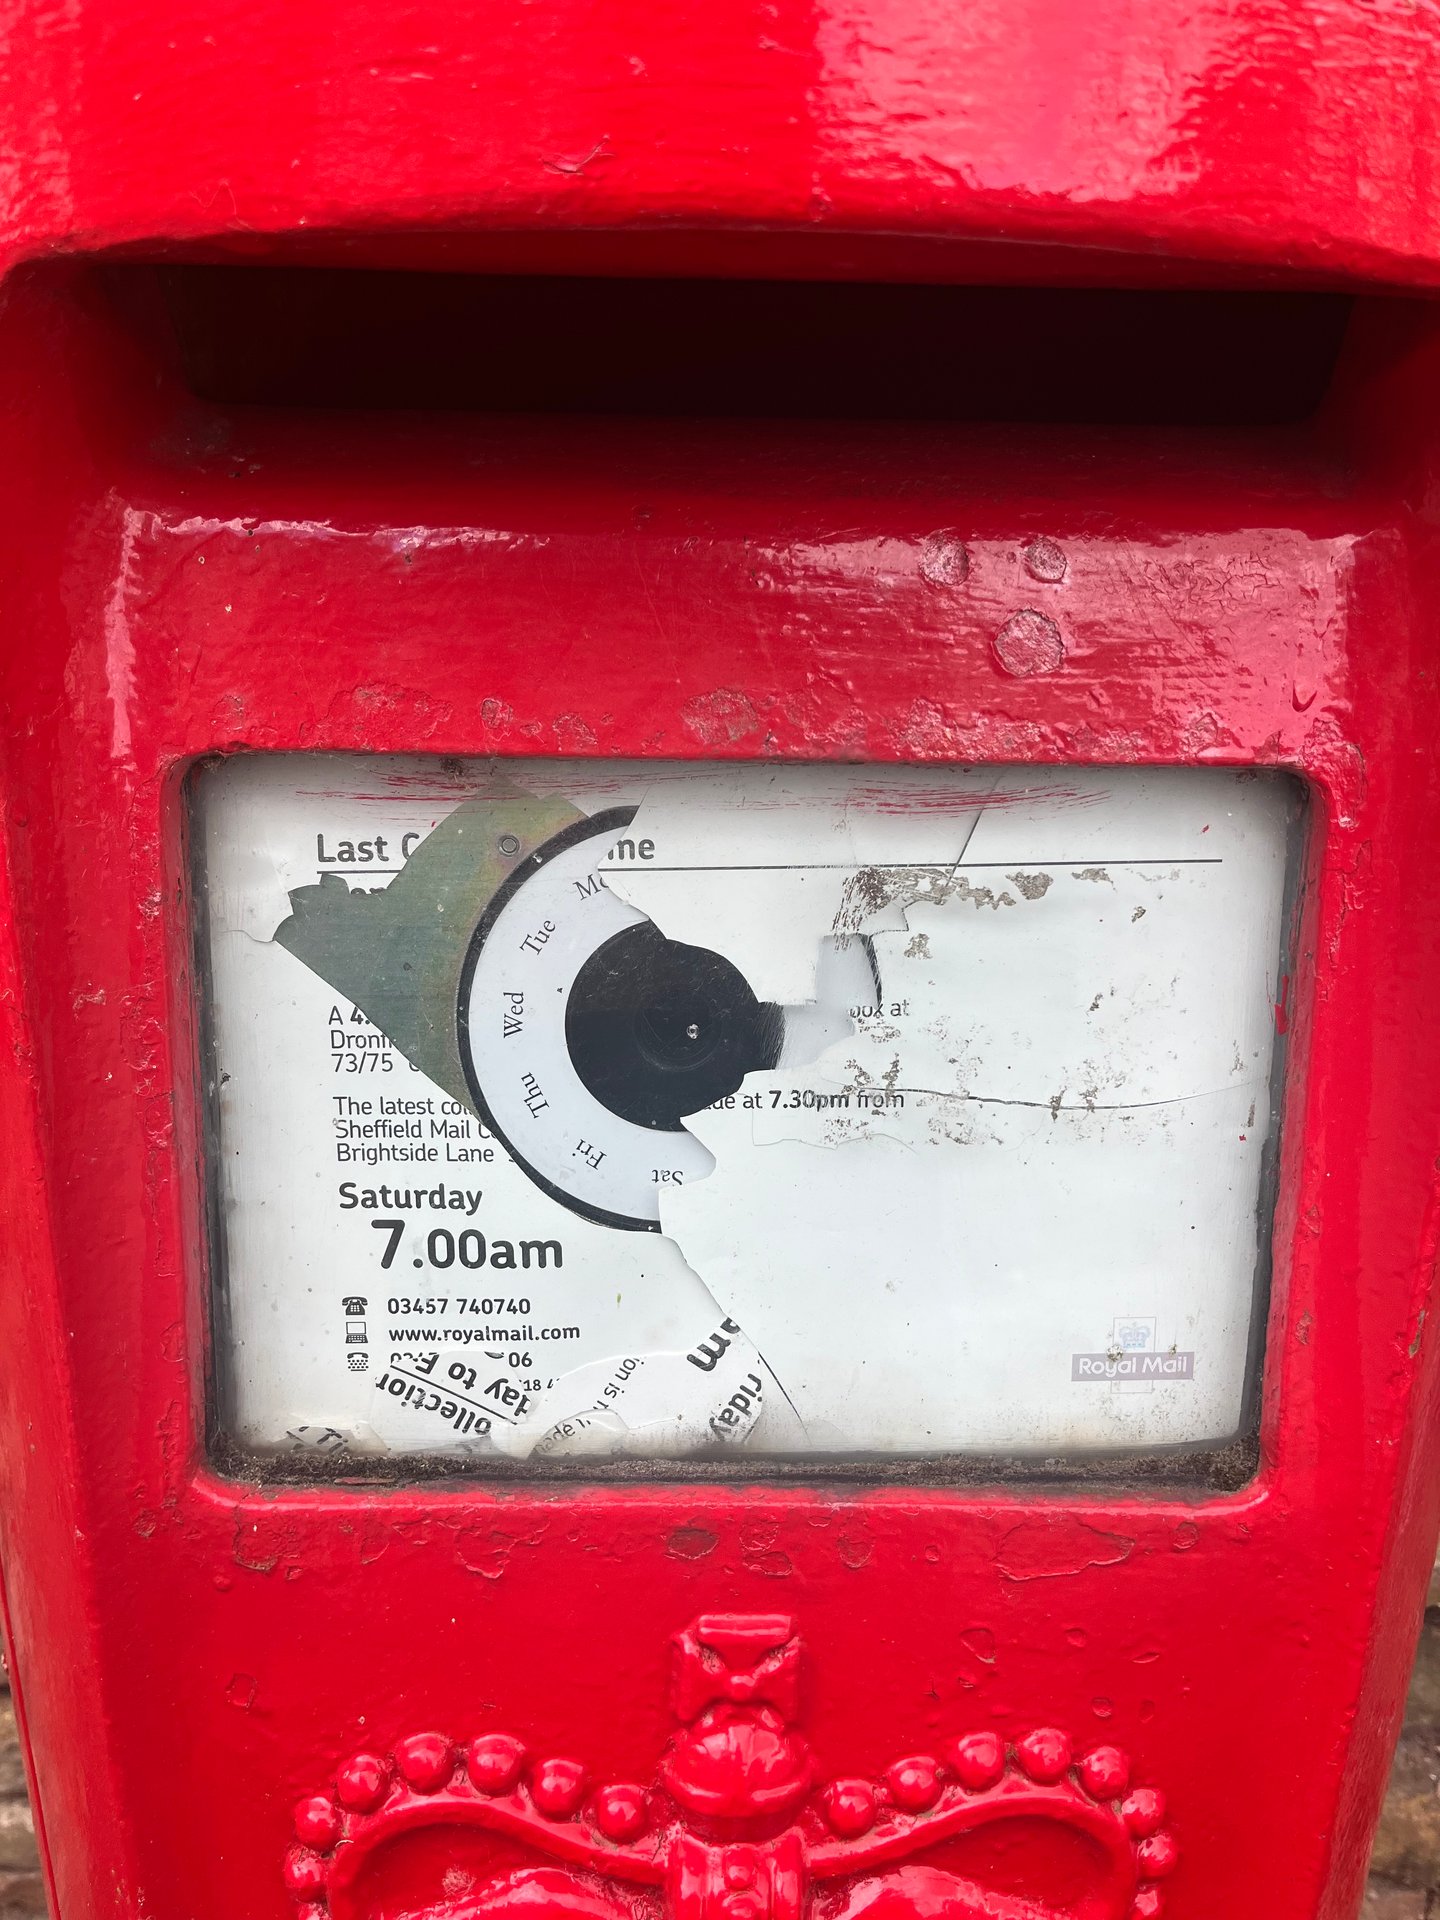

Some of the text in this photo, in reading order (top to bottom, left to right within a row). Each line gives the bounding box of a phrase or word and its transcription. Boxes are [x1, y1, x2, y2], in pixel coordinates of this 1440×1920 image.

[317, 833, 390, 862] Last
[608, 838, 655, 860] me
[519, 919, 556, 955] Tue
[328, 1005, 371, 1026] A 4.
[503, 992, 524, 1039] Wed
[889, 999, 910, 1017] at
[331, 1051, 394, 1074] 73/75
[332, 1095, 373, 1116] The
[379, 1096, 436, 1116] latest
[742, 1092, 763, 1110] at
[768, 1088, 849, 1112] 7.30pm
[521, 1072, 549, 1118] Thu
[335, 1119, 423, 1138] Sheffield
[431, 1118, 471, 1138] Mail
[337, 1142, 495, 1165] Brightside Lane
[571, 1139, 607, 1170] Fri
[651, 1169, 684, 1185] Sat
[339, 1182, 482, 1216] Saturday
[371, 1219, 563, 1269] 7.00am
[387, 1297, 531, 1315] 03457 740740
[388, 1324, 580, 1344] www.royalmail.com
[686, 1316, 741, 1372] am
[508, 1352, 532, 1367] 06
[1079, 1355, 1187, 1378] Royal Mail
[414, 1353, 531, 1416] day to F
[524, 1379, 541, 1391] 18
[709, 1372, 762, 1442] riday
